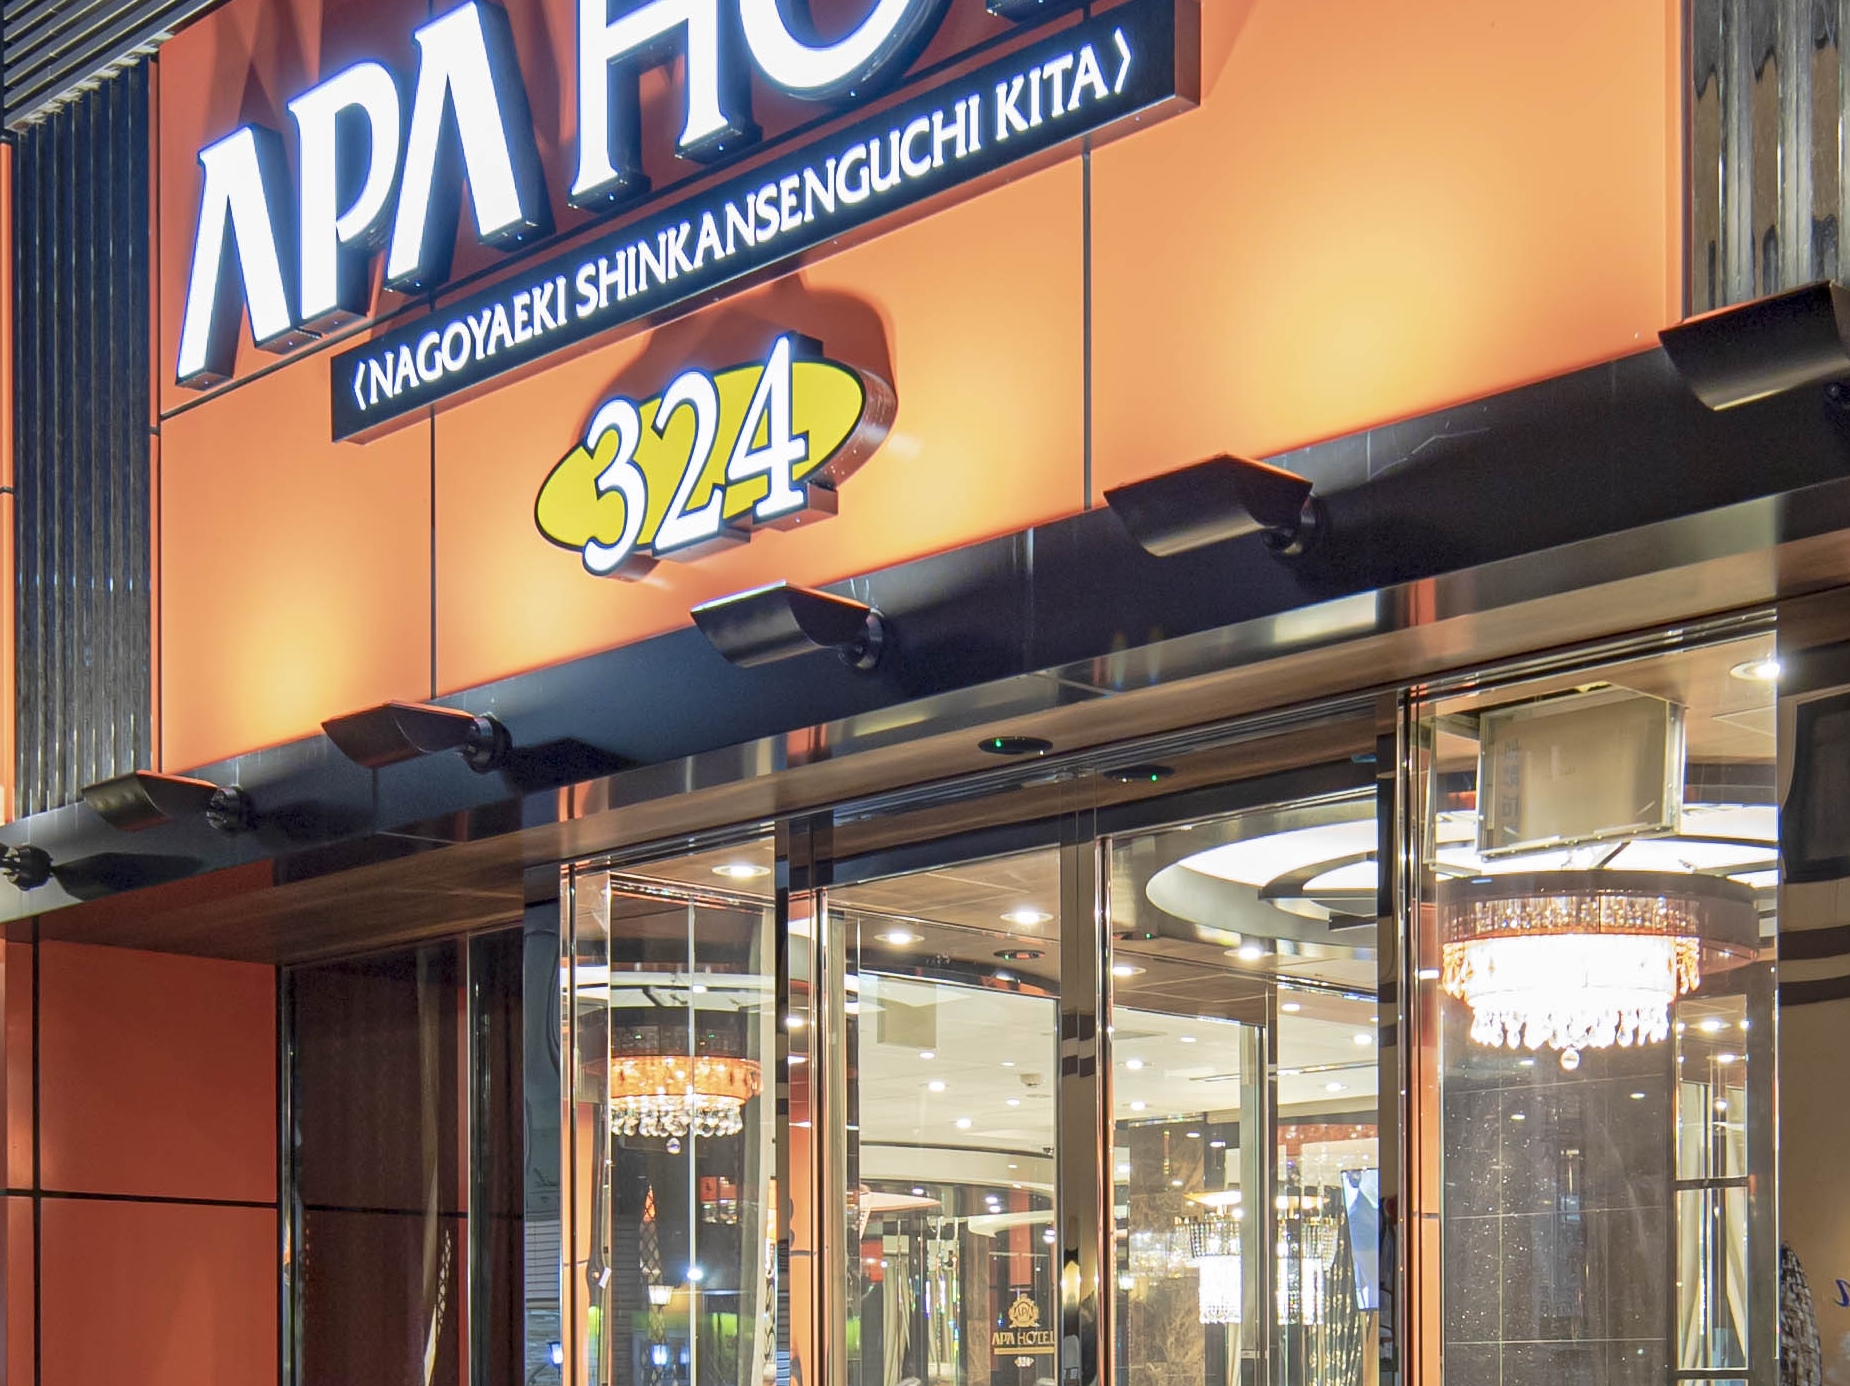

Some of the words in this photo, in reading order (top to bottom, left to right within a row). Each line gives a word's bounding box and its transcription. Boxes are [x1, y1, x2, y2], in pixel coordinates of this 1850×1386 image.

[575, 92, 984, 312] SHINKANSENGUCHI
[582, 332, 811, 577] 324
[991, 1331, 1015, 1345] APA
[1017, 1330, 1055, 1345] HOTEL
